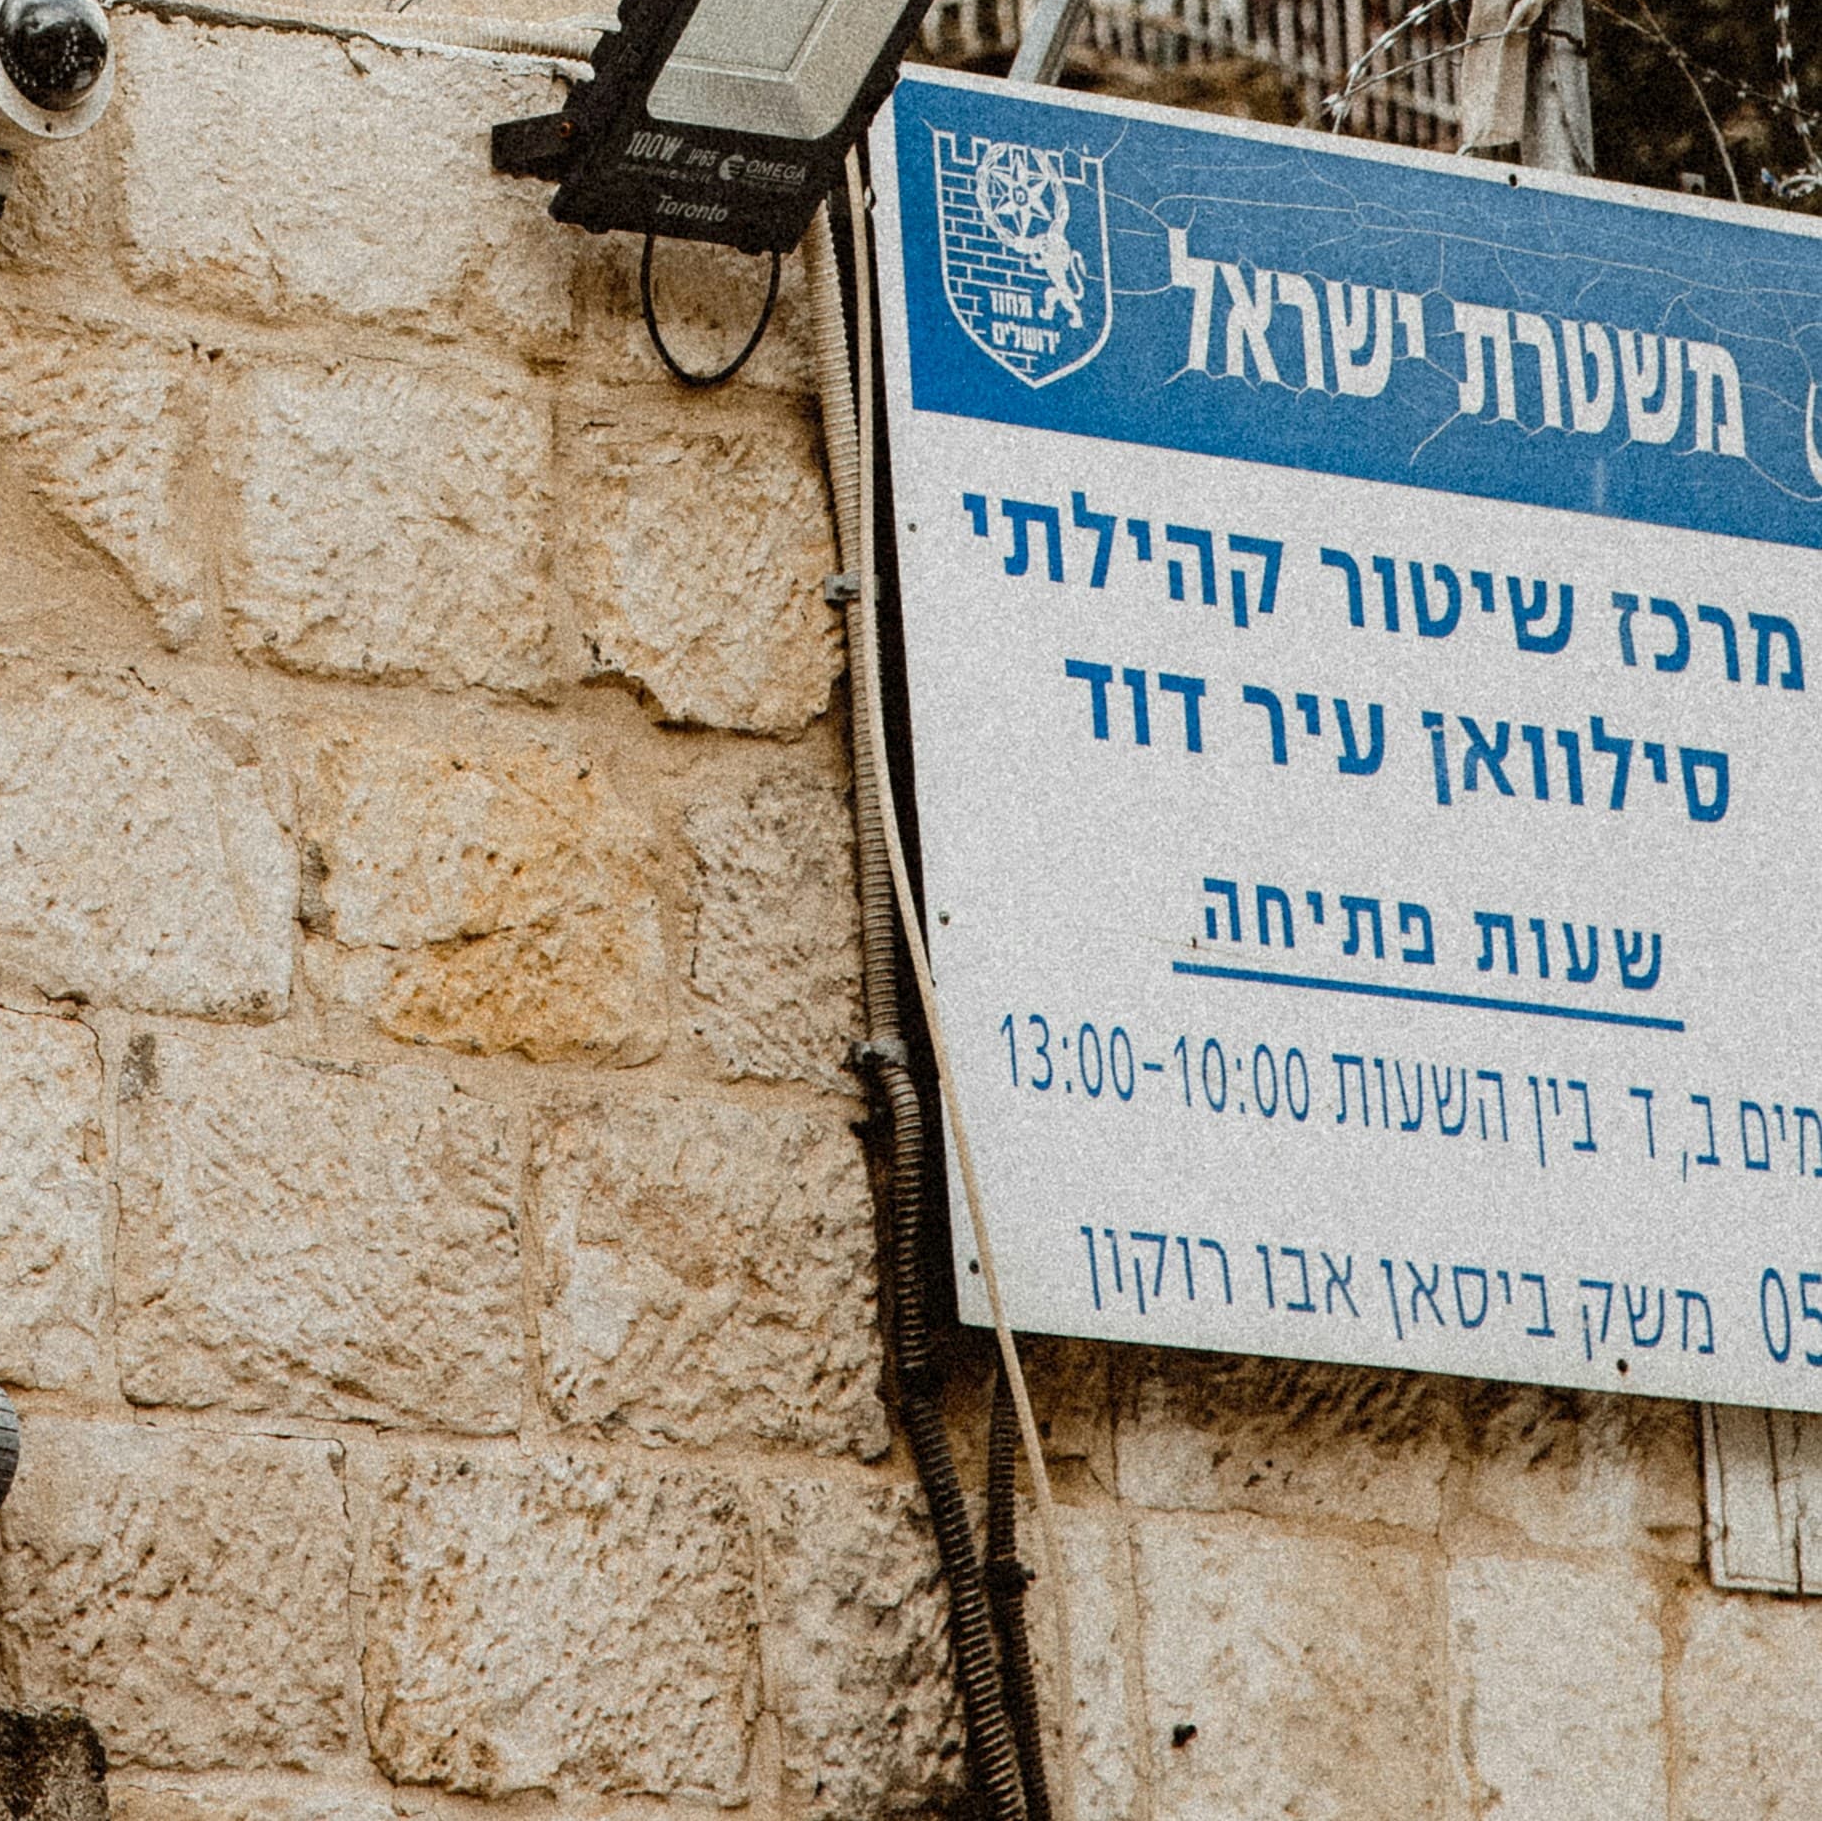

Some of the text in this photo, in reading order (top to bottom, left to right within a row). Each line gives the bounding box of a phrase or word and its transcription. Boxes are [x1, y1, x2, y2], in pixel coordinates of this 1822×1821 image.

[625, 131, 721, 168] 100W IP65
[745, 159, 808, 182] OMEGA
[656, 194, 729, 223] Toronto
[990, 290, 1033, 319] מחוז
[991, 320, 1061, 355] ירושלים
[1169, 227, 1746, 458] משטרת ישראל
[961, 491, 1806, 692] מרכז שיטור קהילתי
[1064, 658, 1731, 823] סילוואן עיר דוד
[1203, 876, 1663, 991] שעות פתיחה
[1329, 1051, 1511, 1143] השעות
[1525, 1073, 1599, 1168] בין
[1078, 1223, 1234, 1315] רוקון
[1254, 1243, 1359, 1315] אבו
[1378, 1256, 1557, 1340] ביסאן
[1577, 1276, 1715, 1360] משק
